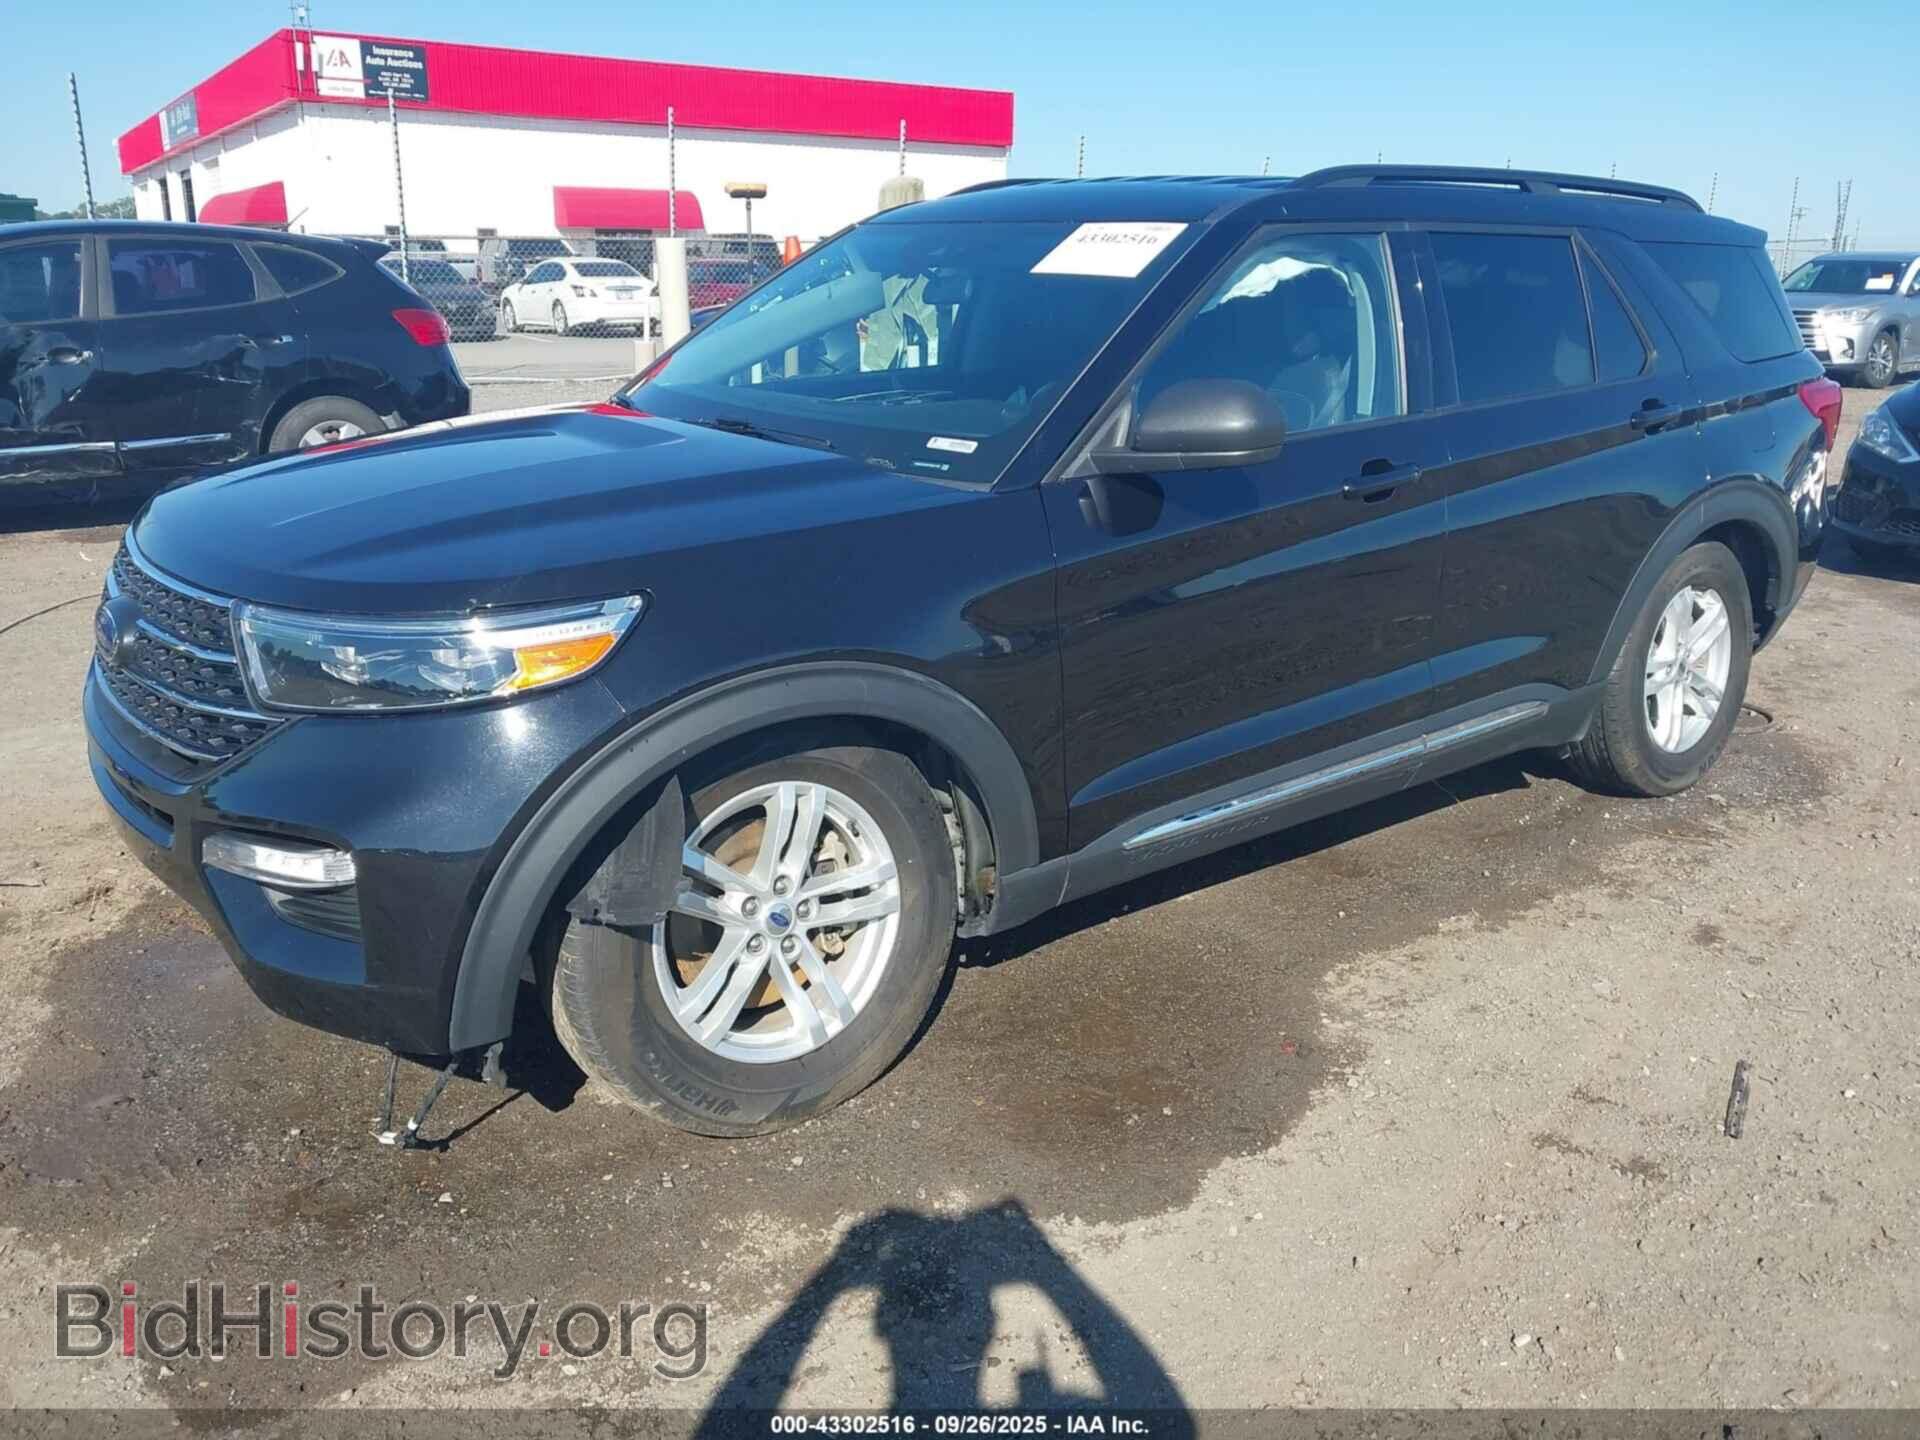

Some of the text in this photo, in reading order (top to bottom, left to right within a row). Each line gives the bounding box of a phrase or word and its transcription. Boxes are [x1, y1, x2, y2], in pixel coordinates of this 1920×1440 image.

[372, 45, 414, 58] Insurance
[365, 55, 423, 69] Auto Auctions
